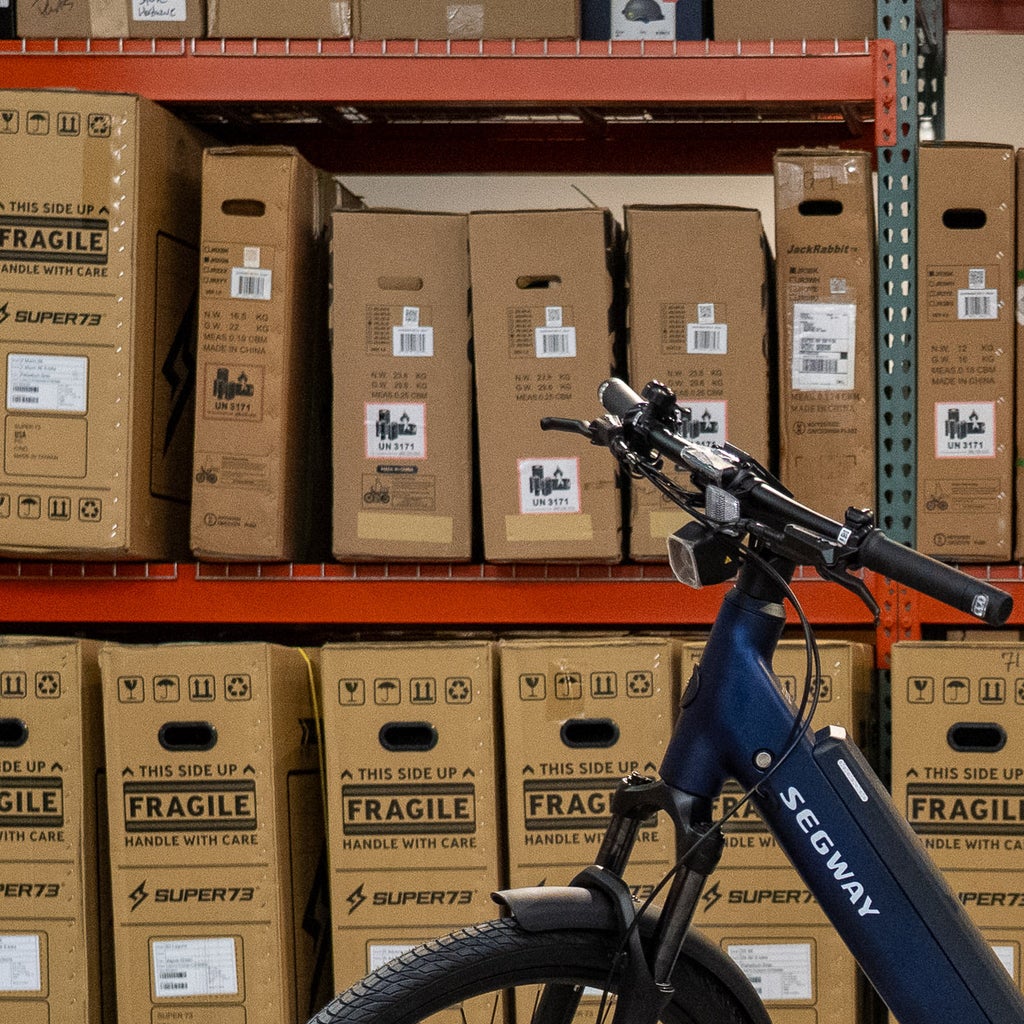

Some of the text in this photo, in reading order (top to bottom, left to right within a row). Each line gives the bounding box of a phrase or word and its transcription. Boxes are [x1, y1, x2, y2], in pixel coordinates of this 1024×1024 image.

[9, 201, 94, 216] THIS SIDE UP
[1, 264, 108, 278] ANDLE WITH CARE
[14, 310, 102, 326] SUPER73
[532, 498, 569, 506] UN 3171
[26, 760, 46, 772] UP
[140, 764, 238, 778] THIS SIDE UP
[540, 762, 639, 776] THIS SIDE UP
[358, 767, 457, 780] THIS SIDE UP
[924, 767, 1024, 780] THIS SIDE UP
[129, 794, 250, 818] FRAGILE
[348, 798, 470, 820] FRAGILE
[529, 792, 614, 816] FRAG
[30, 831, 64, 842] CARE
[125, 834, 258, 848] HANDLE WITH CARE
[343, 837, 477, 850] HANDLE WITH CARE
[524, 833, 579, 846] HANDLE
[965, 838, 1000, 850] WITH
[780, 786, 880, 917] SEGWAY
[155, 886, 255, 903] SUPER73
[373, 890, 472, 906] SUPER73
[158, 1012, 182, 1020] SUPER
